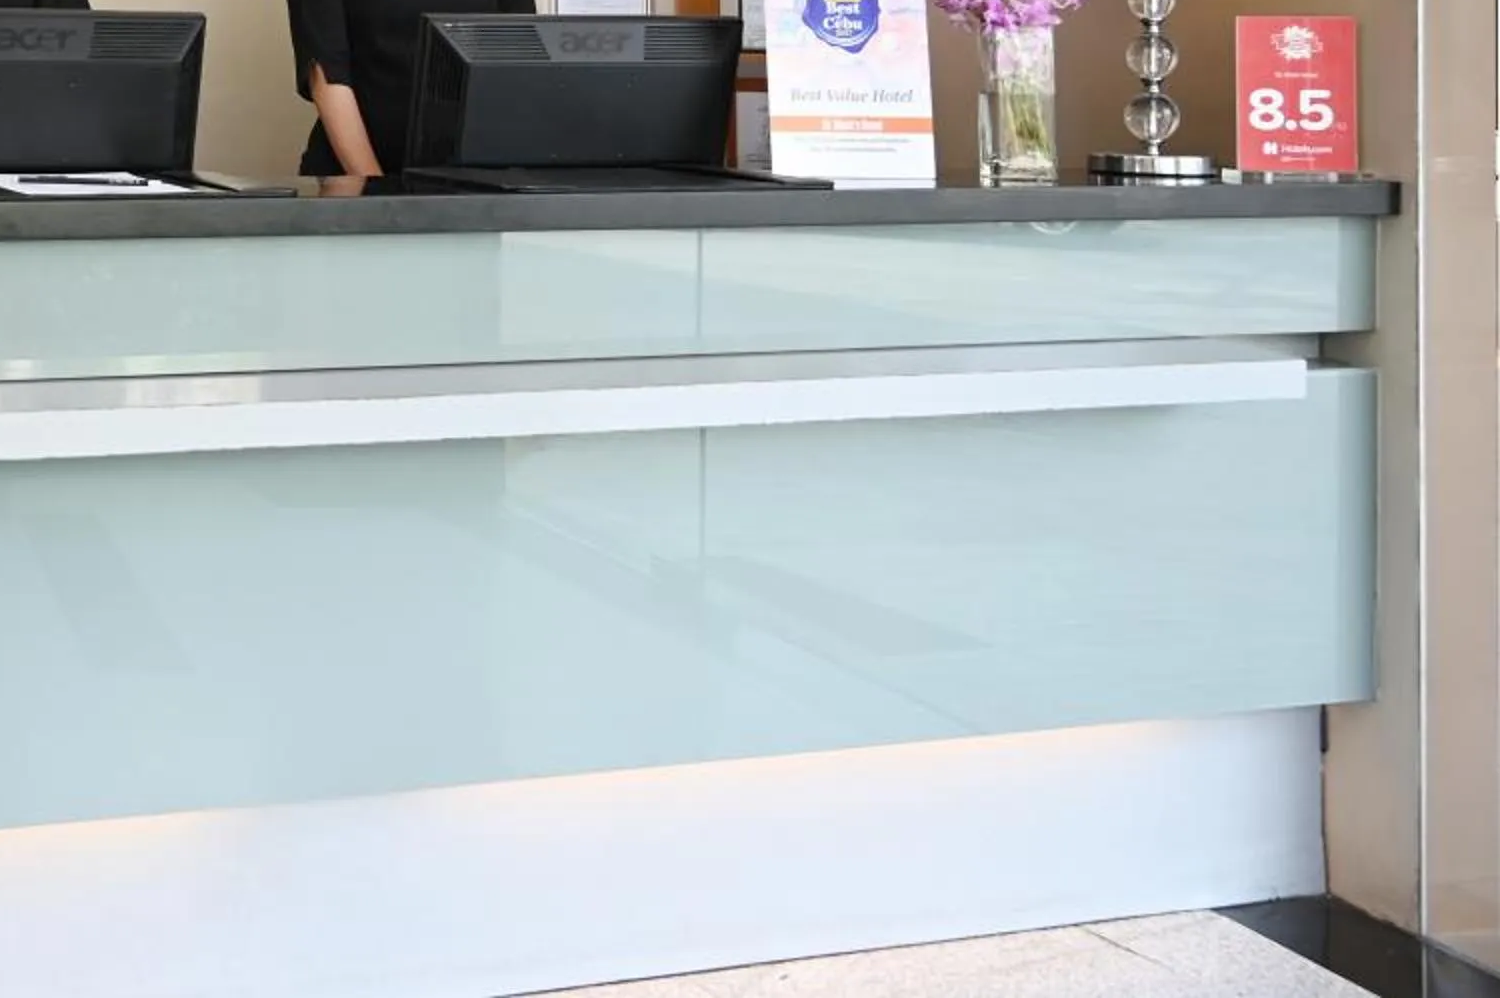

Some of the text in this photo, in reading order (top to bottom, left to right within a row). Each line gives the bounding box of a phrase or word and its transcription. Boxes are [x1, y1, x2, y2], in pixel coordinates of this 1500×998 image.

[826, 1, 860, 15] Best
[823, 15, 863, 31] Cebu
[560, 30, 633, 53] acer
[790, 88, 914, 103] Best Value Hotel
[1248, 87, 1335, 131] 8.5
